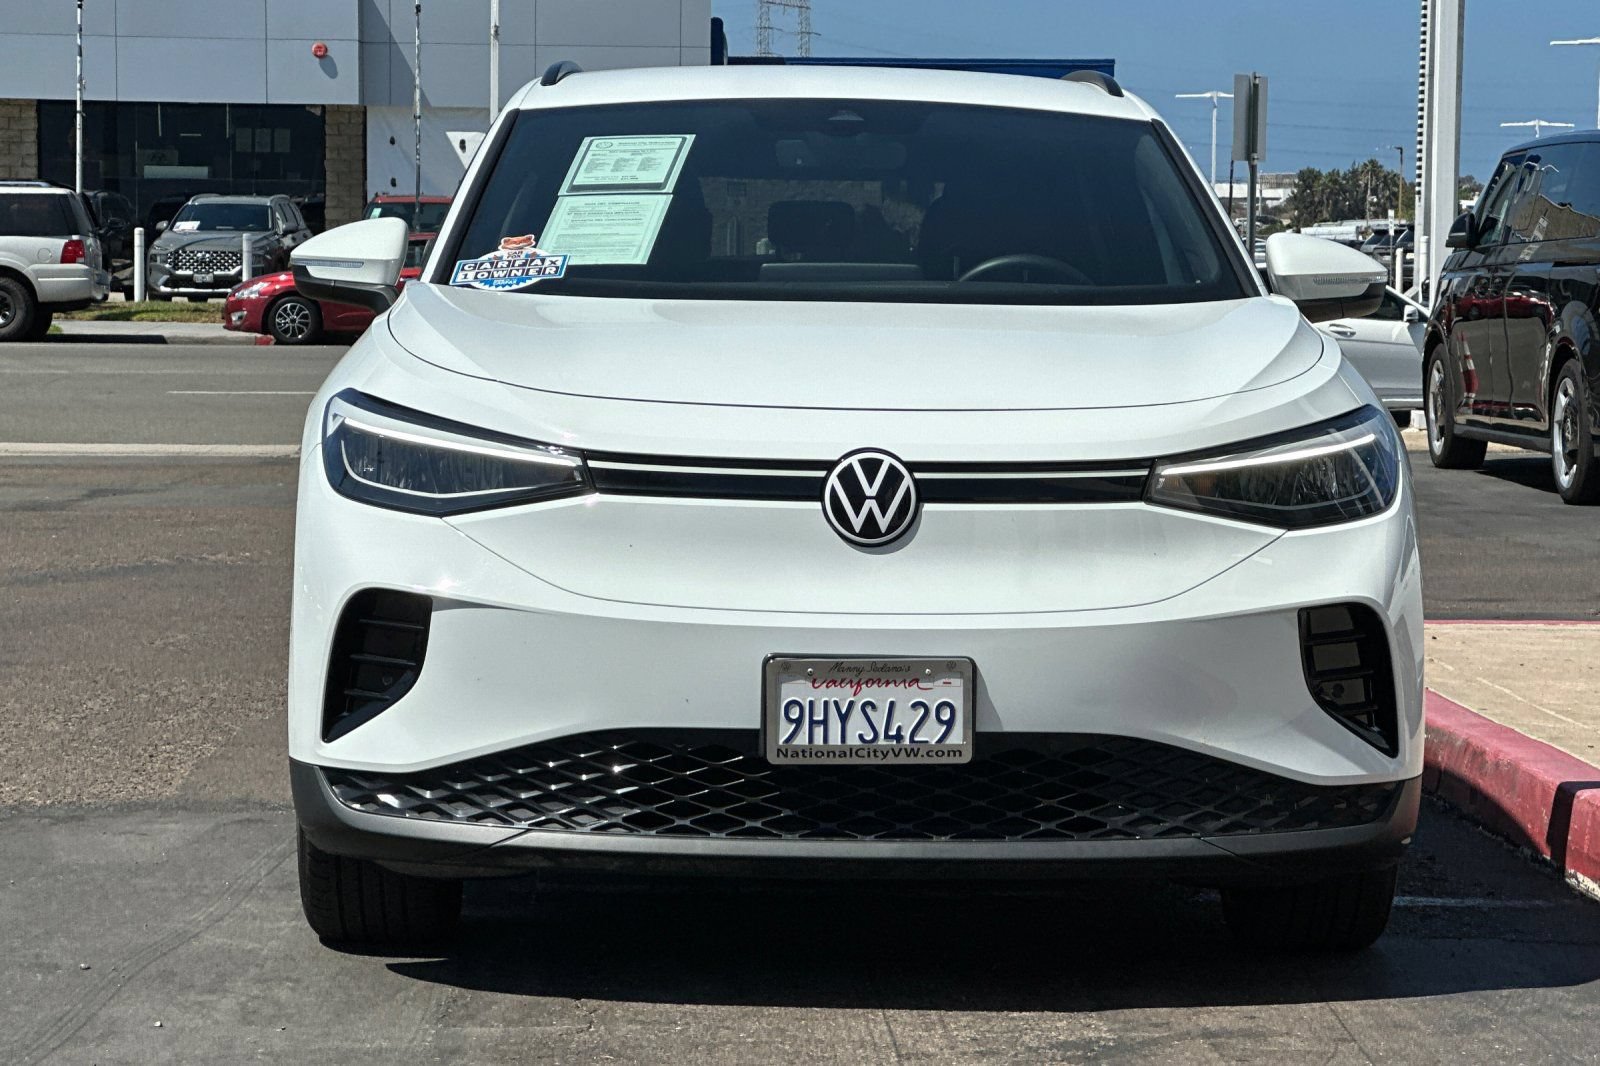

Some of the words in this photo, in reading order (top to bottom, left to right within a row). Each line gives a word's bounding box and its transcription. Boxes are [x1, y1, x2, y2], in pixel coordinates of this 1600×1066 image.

[463, 258, 559, 271] CARFAX
[460, 272, 470, 280] 1
[476, 266, 556, 279] OWNER
[829, 661, 864, 677] Manny
[782, 699, 957, 745] 9HYS429
[776, 747, 963, 761] NationalCityVW.com
